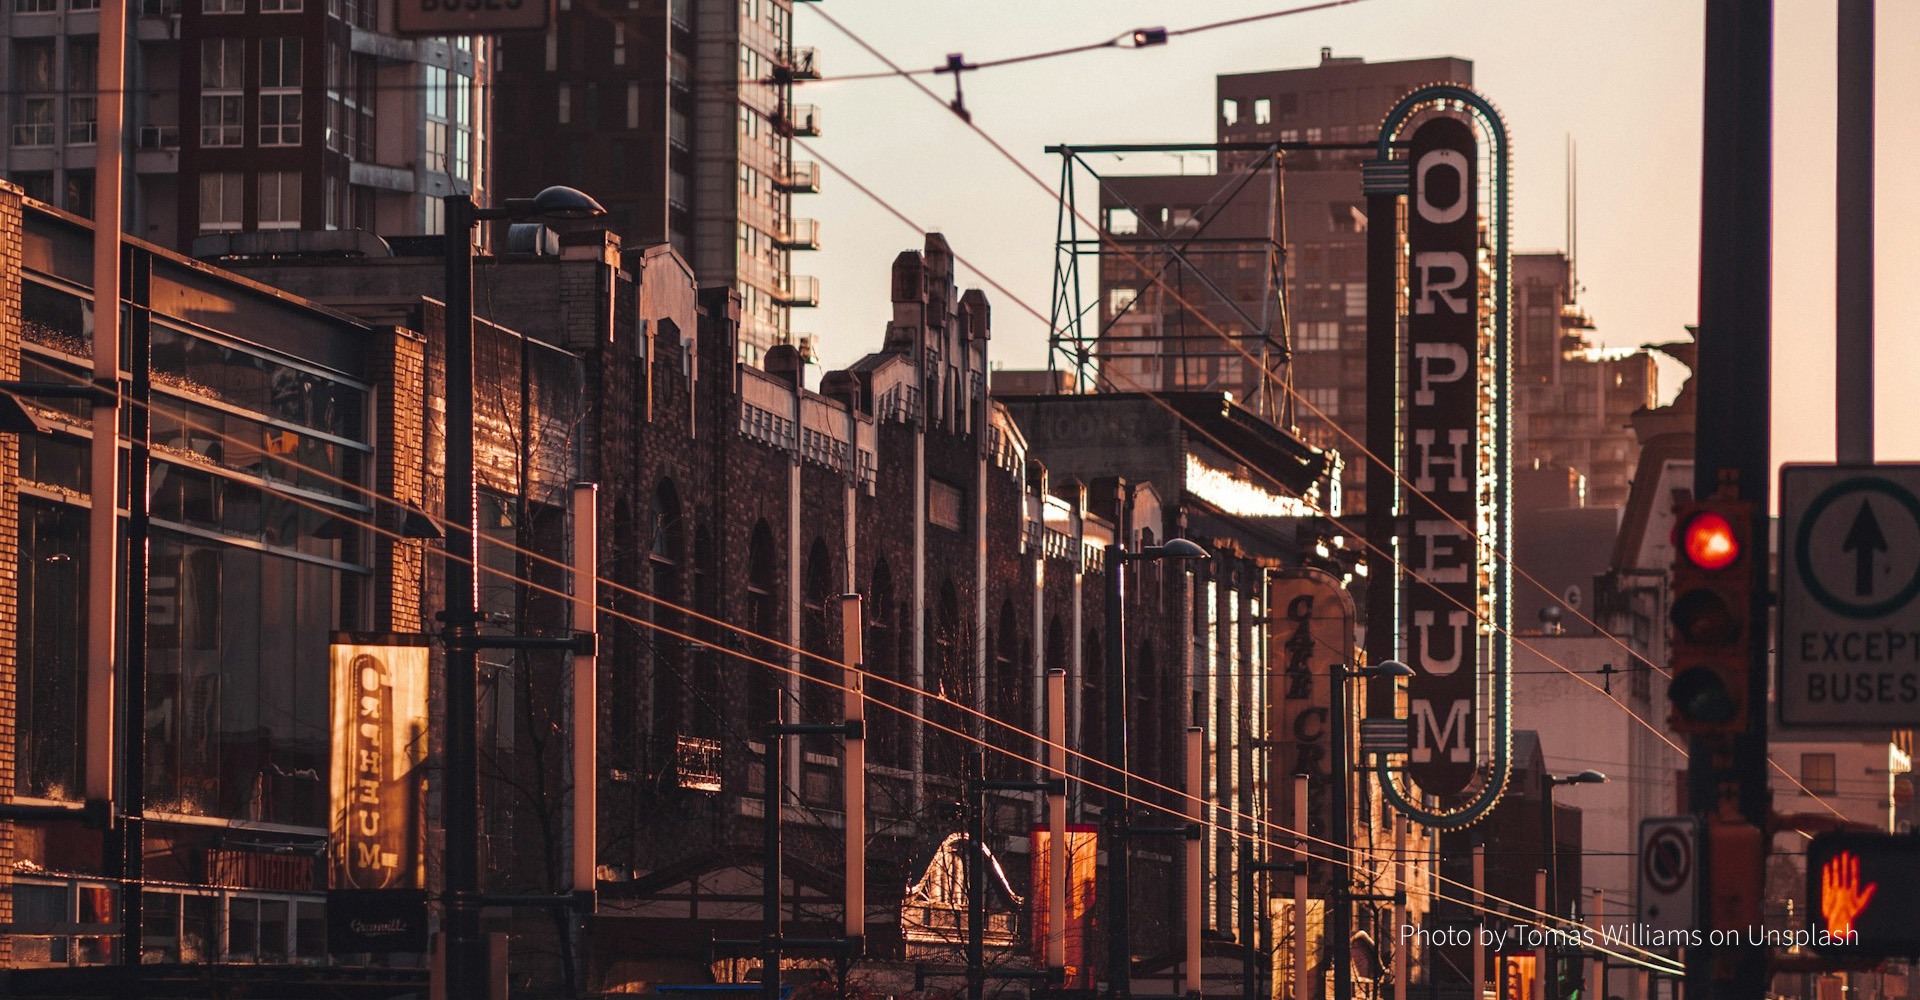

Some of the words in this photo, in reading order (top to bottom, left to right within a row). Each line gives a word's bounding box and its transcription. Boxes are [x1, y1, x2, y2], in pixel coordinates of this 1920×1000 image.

[1411, 149, 1470, 763] ORPHEUM
[1801, 631, 1920, 662] EXCEPT
[1808, 672, 1918, 703] BUSES
